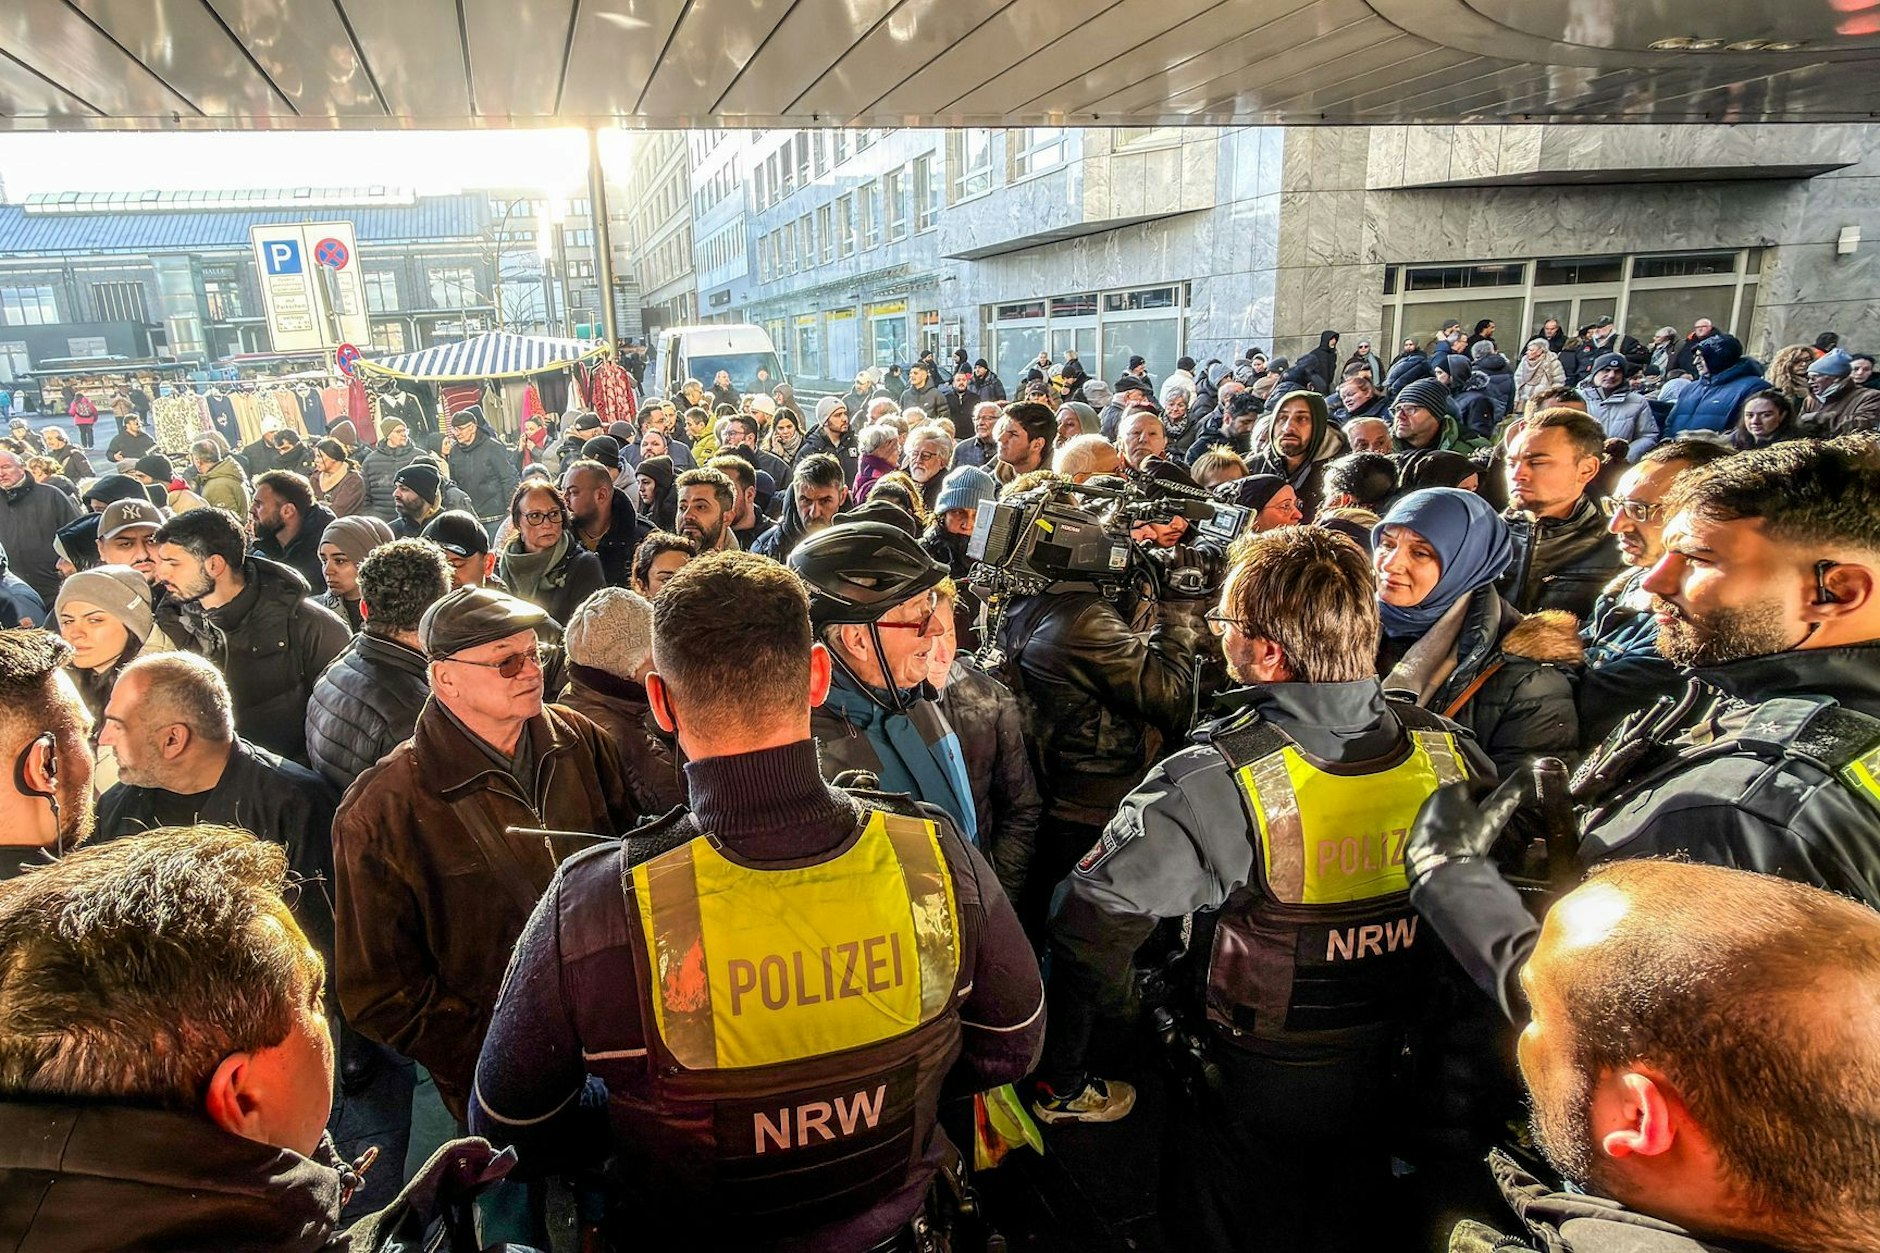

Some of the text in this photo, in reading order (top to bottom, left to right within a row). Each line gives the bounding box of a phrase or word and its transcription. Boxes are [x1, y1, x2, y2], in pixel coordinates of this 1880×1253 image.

[1317, 828, 1407, 876] POLIZ
[1326, 915, 1418, 961] NRW
[728, 932, 903, 1016] POLIZEI
[753, 1084, 887, 1154] NRW
